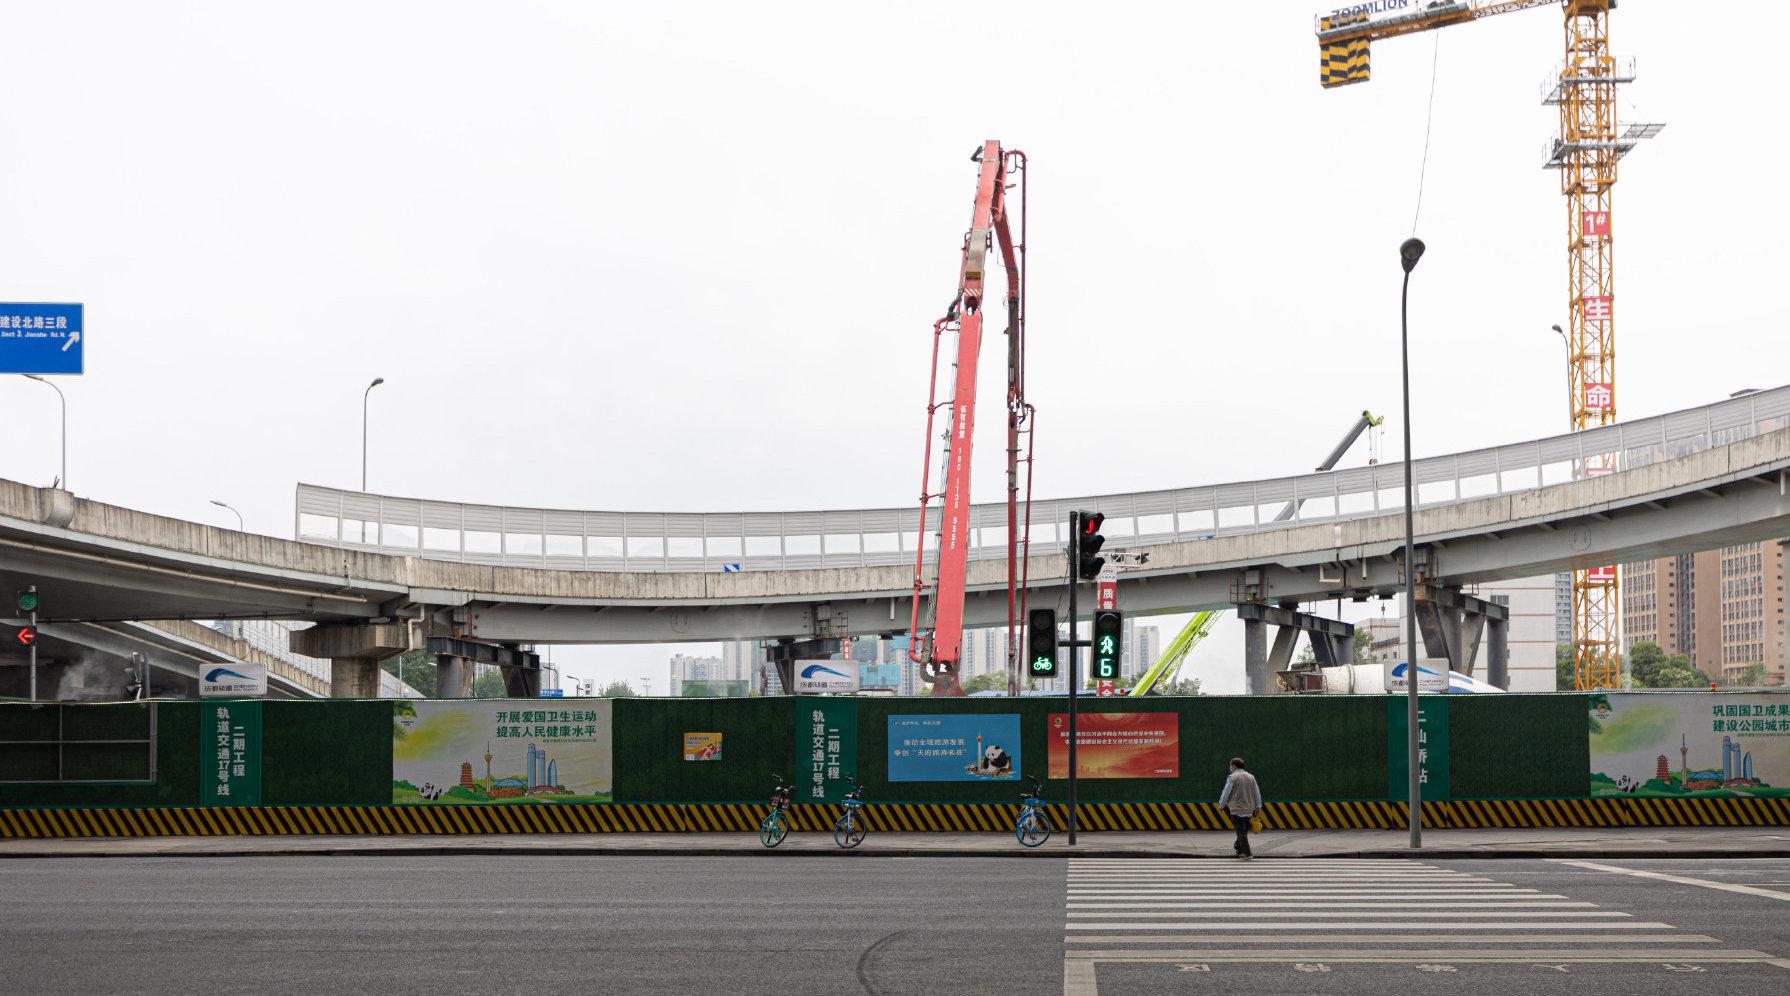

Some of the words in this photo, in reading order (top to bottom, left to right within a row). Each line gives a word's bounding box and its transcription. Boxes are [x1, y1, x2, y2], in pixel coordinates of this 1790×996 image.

[1585, 213, 1606, 234] 1#
[0, 315, 67, 329] 建设北路三段
[1101, 658, 1112, 677] 6
[496, 710, 597, 723] 开展爱国卫生运动
[1713, 704, 1790, 717] 巩固国卫成果
[496, 725, 597, 738] 提高人民健康水平
[1713, 719, 1790, 732] 建设公园城市
[217, 707, 230, 796] 轨道交通17号线
[233, 726, 245, 776] 二期工程
[812, 710, 825, 798] 轨道交通17号线
[828, 728, 840, 779] 二期工程
